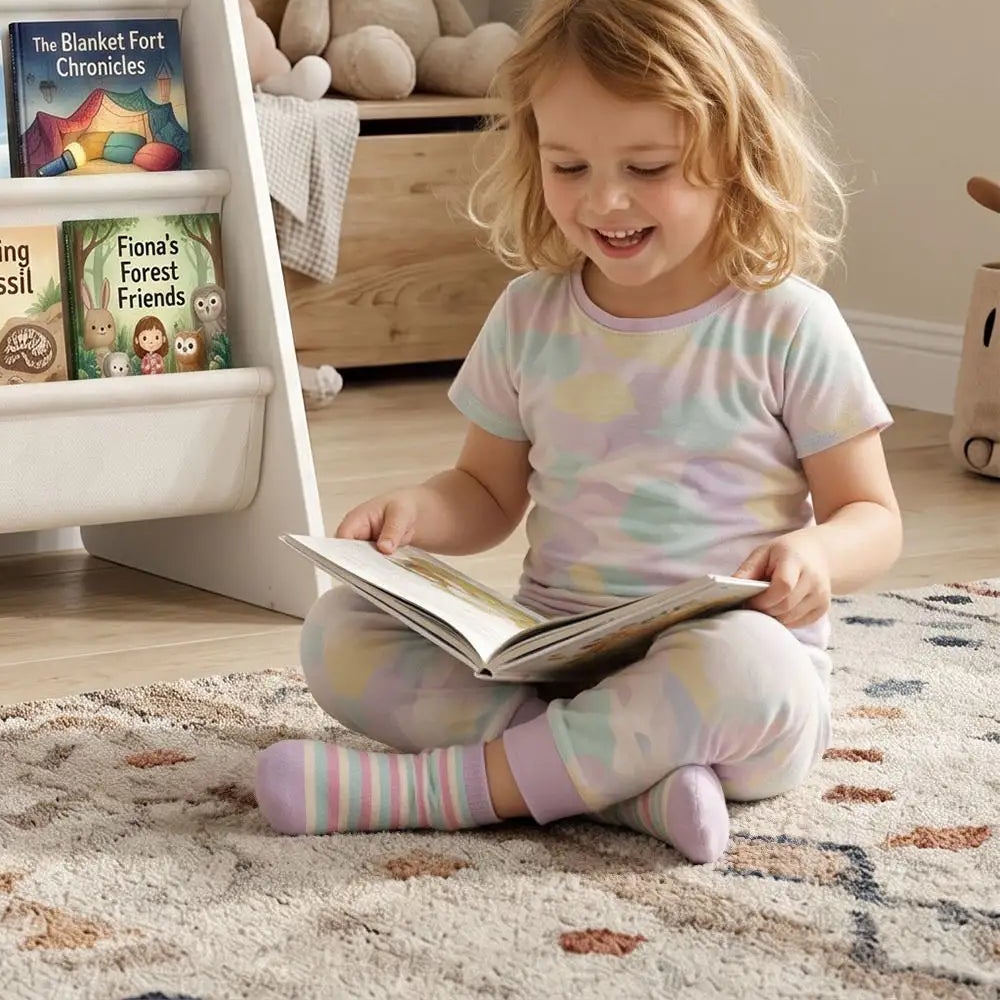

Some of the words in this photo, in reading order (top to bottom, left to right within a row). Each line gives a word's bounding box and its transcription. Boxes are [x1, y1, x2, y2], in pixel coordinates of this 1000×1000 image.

[33, 36, 57, 52] The
[61, 31, 124, 52] Blanket
[129, 30, 165, 50] Fort
[56, 56, 146, 77] Chronicles
[117, 233, 179, 258] Fiona's
[120, 260, 179, 284] Forest
[118, 286, 185, 309] Friends
